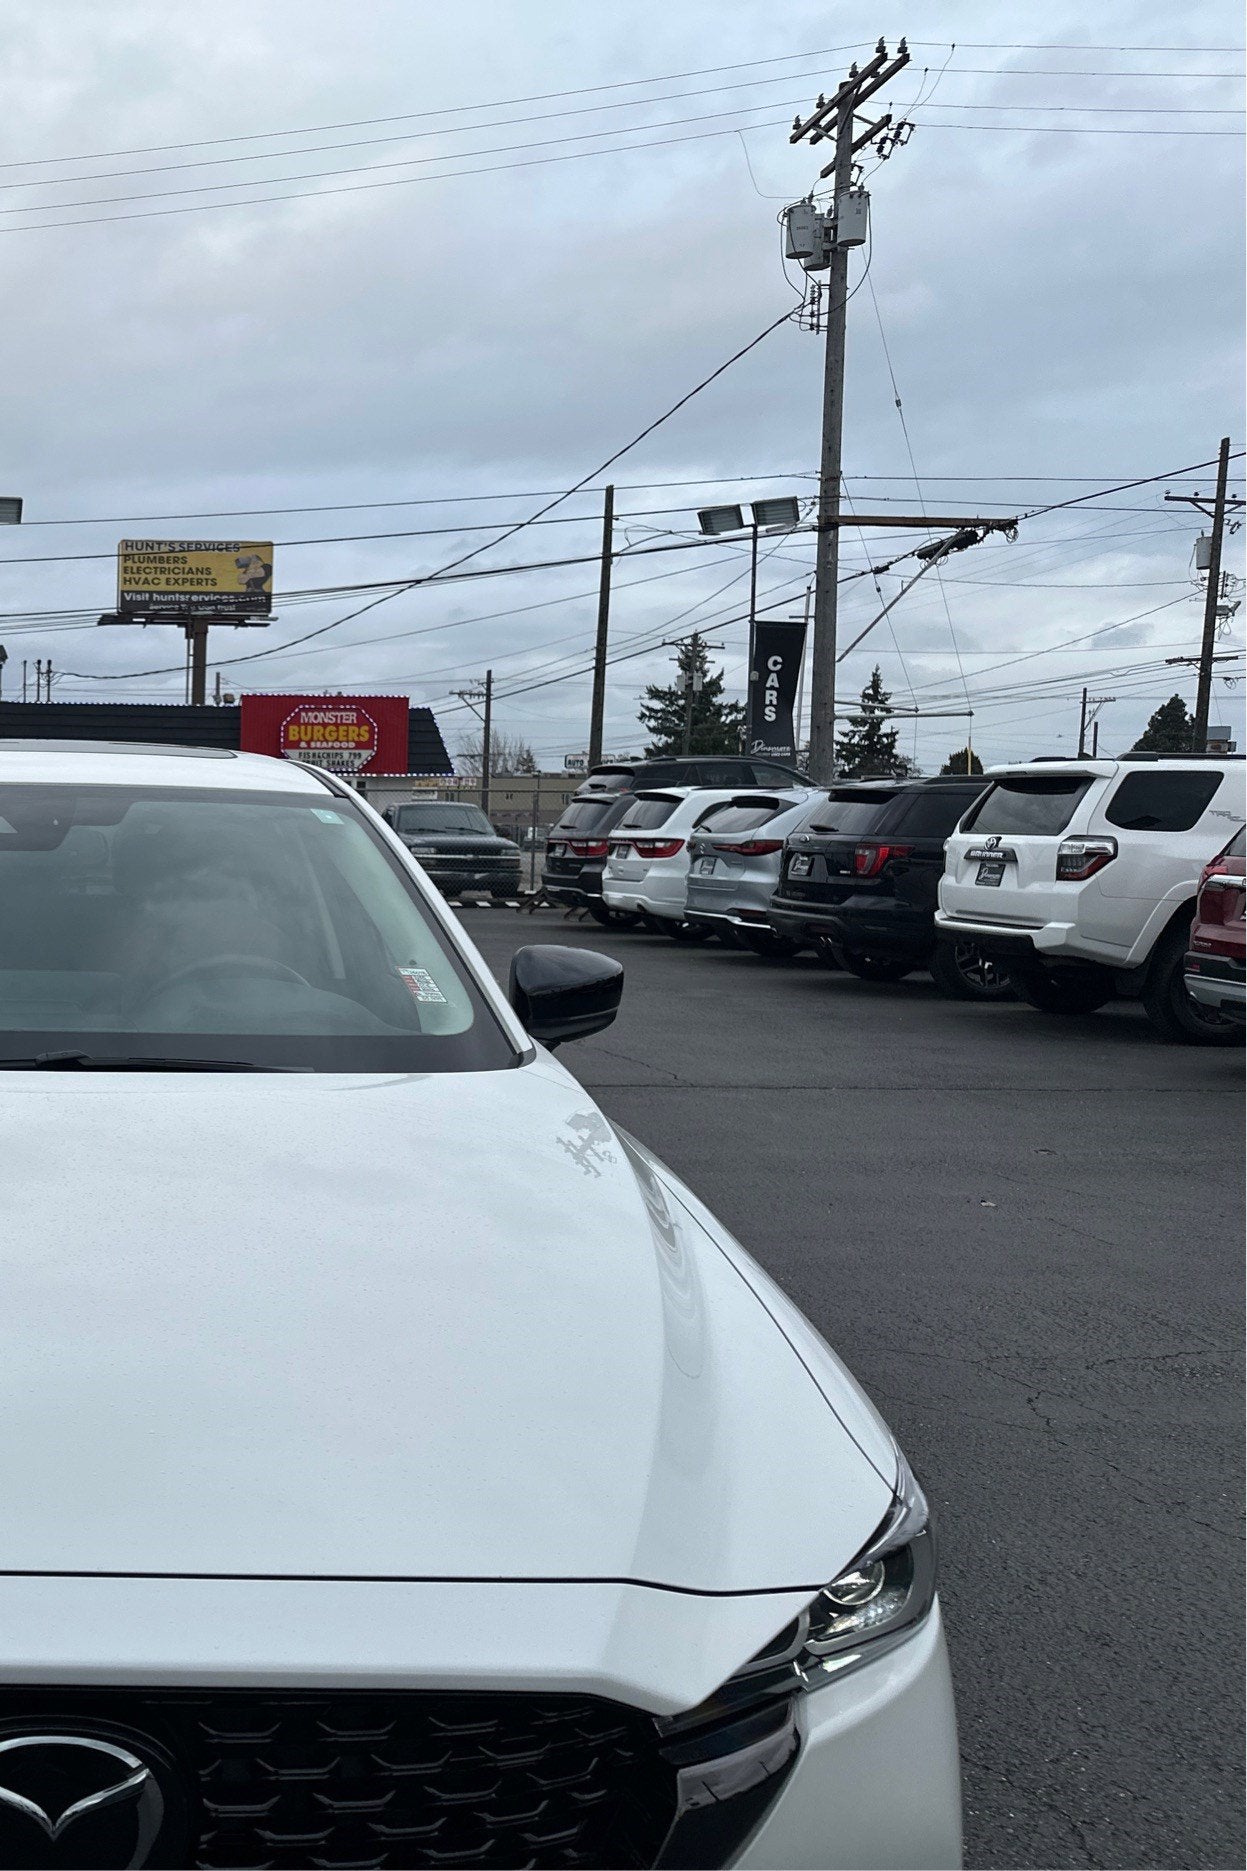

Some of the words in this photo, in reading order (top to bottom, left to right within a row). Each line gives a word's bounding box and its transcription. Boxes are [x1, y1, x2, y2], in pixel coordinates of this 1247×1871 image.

[125, 542, 176, 552] HUNT'S
[179, 542, 240, 552] SERVICES
[124, 555, 188, 564] PLUMBERS
[124, 566, 212, 575] ELECTRICIANS
[124, 577, 161, 586] HVAC
[166, 577, 218, 586] EXPERTS
[124, 593, 149, 601] Visit
[764, 655, 783, 722] CARS
[300, 712, 357, 723] MONSTER
[288, 726, 370, 742] BURGERS
